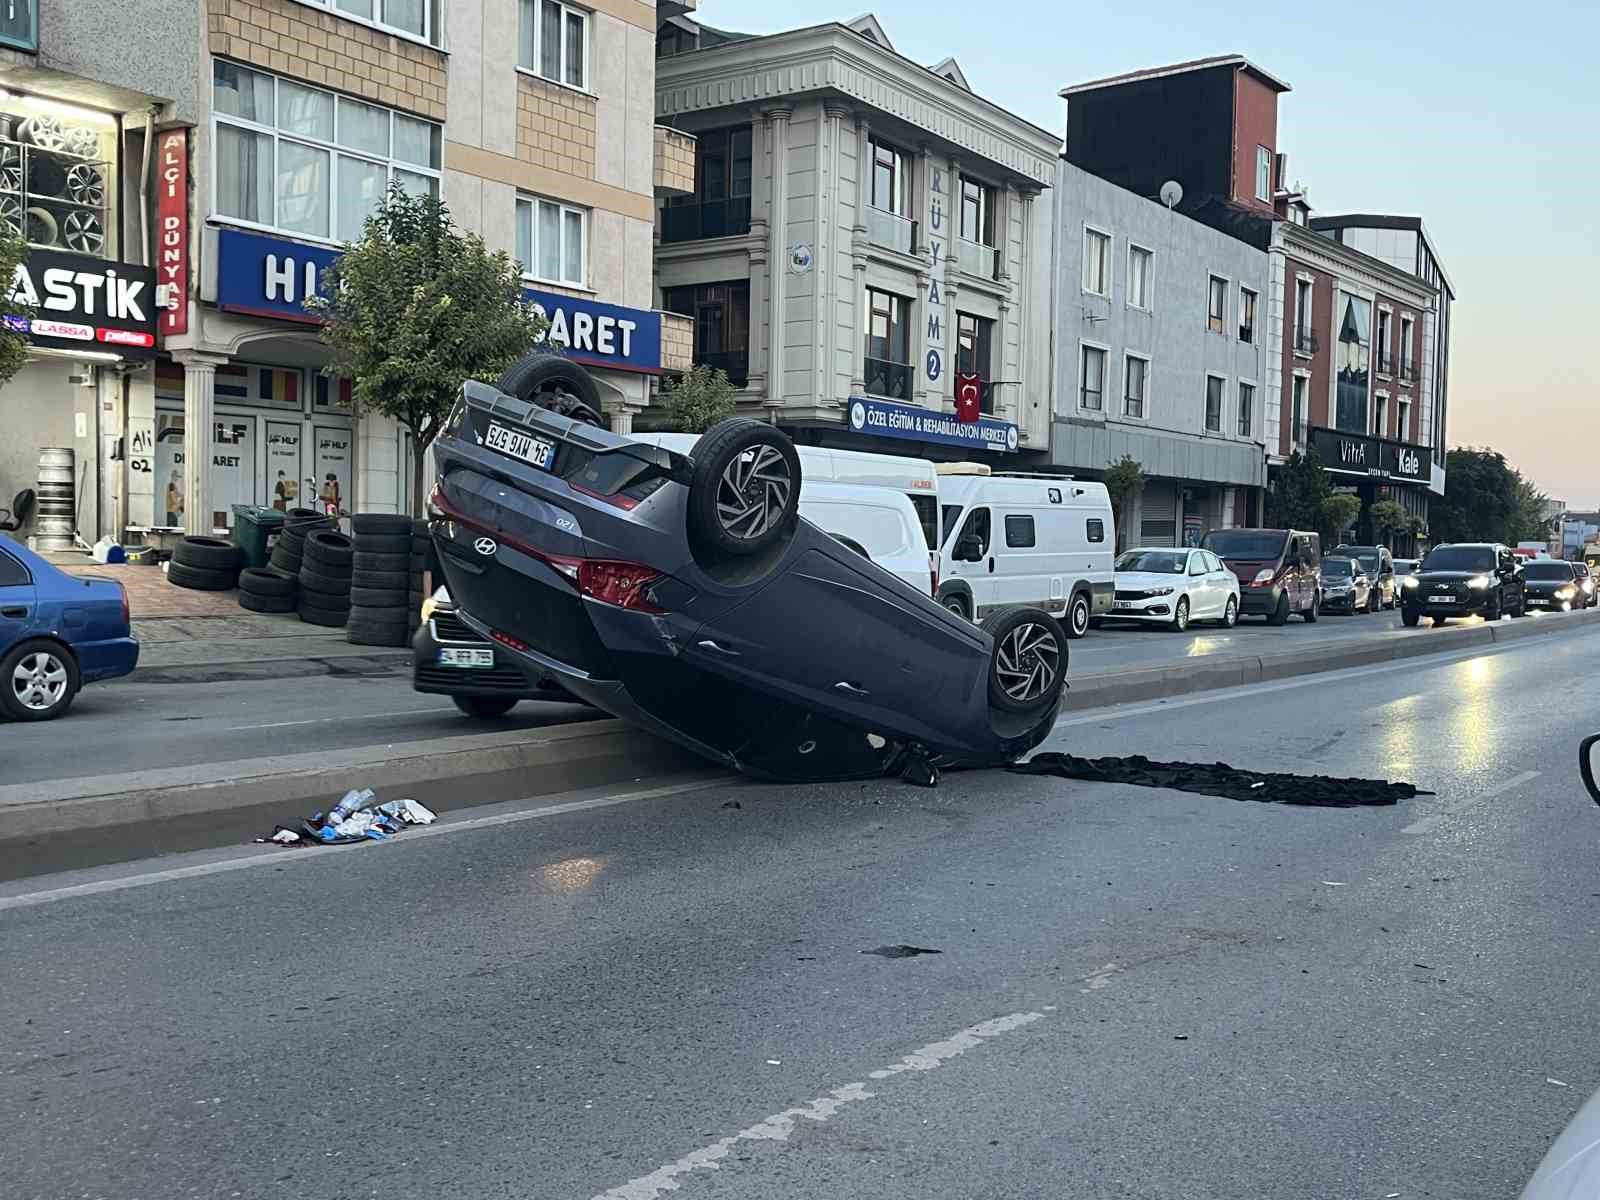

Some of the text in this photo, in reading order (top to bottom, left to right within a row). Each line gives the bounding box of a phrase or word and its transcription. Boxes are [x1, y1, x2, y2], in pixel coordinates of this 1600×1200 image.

[163, 135, 181, 327] ALÇI DÜNYASI
[927, 168, 942, 340] RÜYAM
[5, 263, 147, 321] ASTİK
[531, 303, 637, 357] CARET
[488, 426, 509, 449] 575
[867, 405, 888, 427] ÖZEL
[888, 410, 915, 431] EĞİTİM
[915, 416, 922, 432] &
[979, 426, 1007, 444] MERKEZİ
[213, 455, 241, 468] ARET
[534, 443, 549, 464] 34
[1398, 447, 1420, 475] Kale
